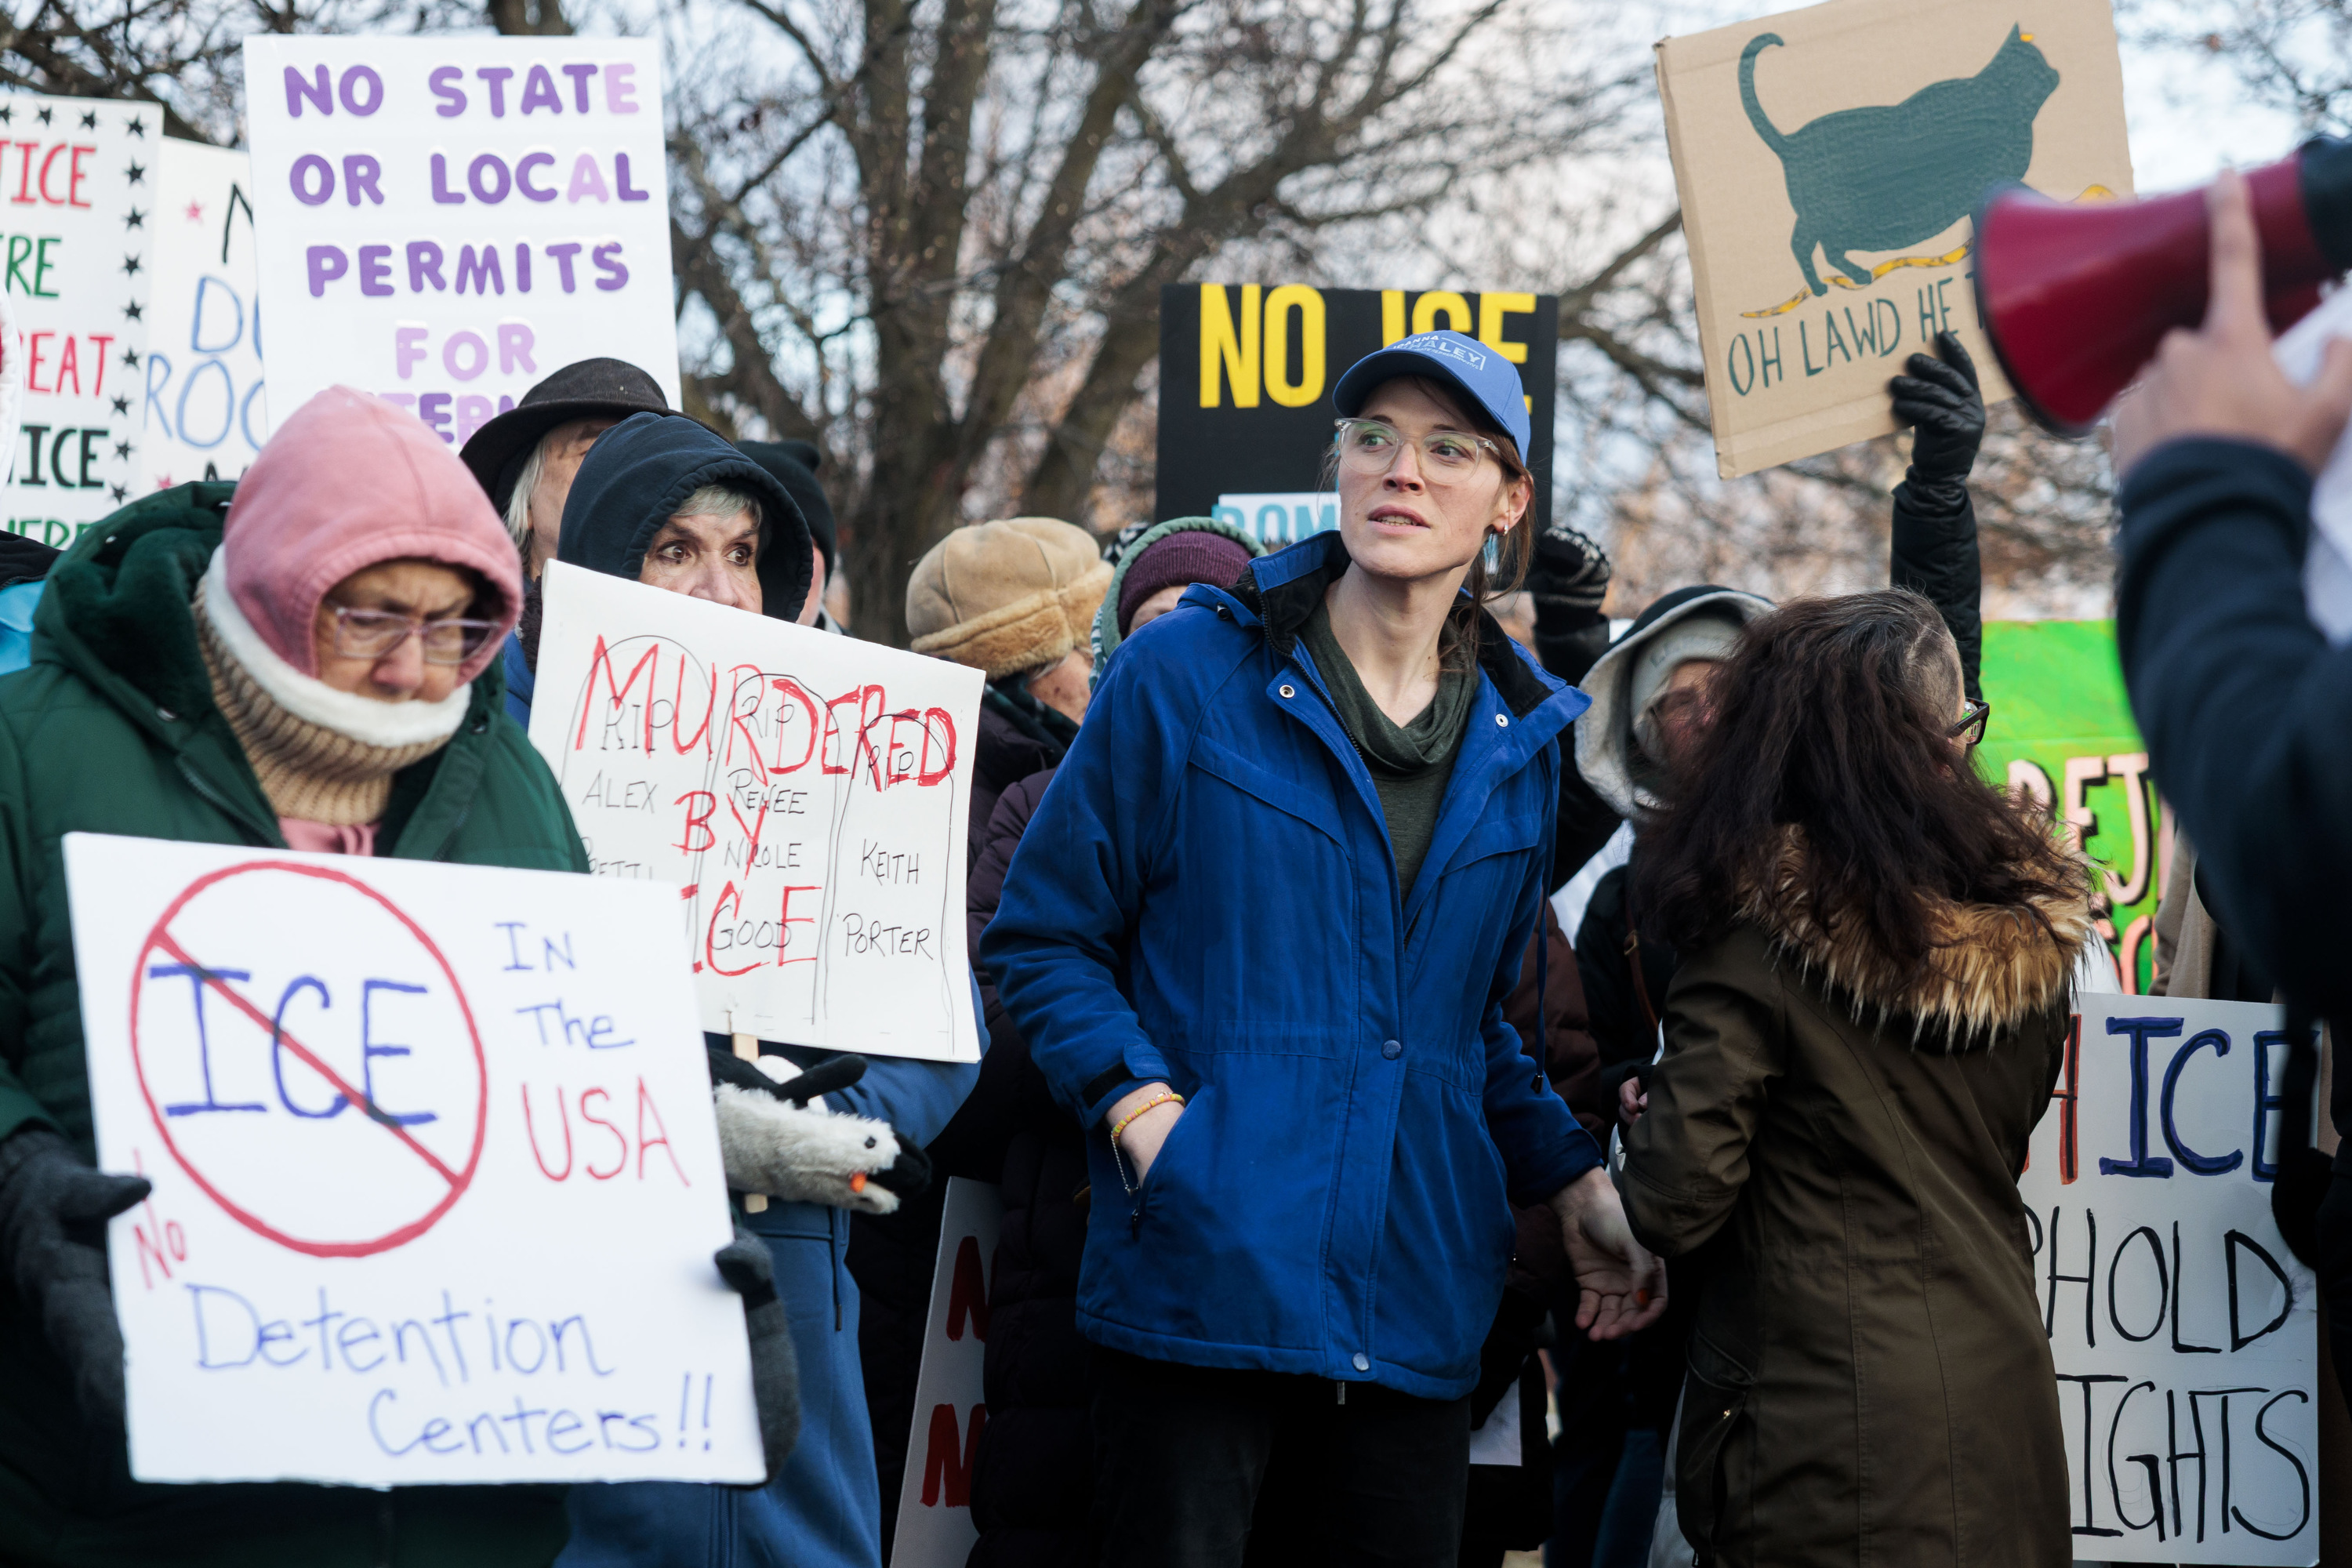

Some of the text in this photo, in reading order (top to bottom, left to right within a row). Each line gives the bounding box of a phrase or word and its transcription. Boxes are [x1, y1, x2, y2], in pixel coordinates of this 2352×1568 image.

[284, 64, 639, 118] NO STATE
[289, 152, 649, 206] OR LOCAL
[0, 234, 62, 298] RE
[307, 241, 629, 297] PERMITS
[19, 332, 115, 397] EAT
[395, 324, 537, 382] FOR
[1200, 282, 1327, 408] NO
[1403, 339, 1481, 363] HALEY
[1729, 326, 1782, 396] OH
[1800, 299, 1900, 377] LAWD
[1918, 277, 1958, 343] HE
[8, 424, 109, 489] ICE
[575, 633, 957, 793] MURDERED
[601, 695, 675, 751] RIP
[741, 695, 795, 739] RIP
[582, 769, 659, 814] ALEX
[728, 768, 808, 814] RENEE
[866, 745, 914, 791] RIP
[671, 790, 769, 880] BY
[724, 837, 802, 869] NICOLE
[861, 838, 919, 886] KEITH
[494, 921, 576, 971] IN
[710, 904, 792, 951] GOOD
[843, 913, 934, 960] PORTER
[148, 963, 439, 1126] ICE
[515, 996, 636, 1049] The
[521, 1074, 691, 1187] USA
[184, 1284, 616, 1387] Detention
[368, 1373, 713, 1455] Centers!!
[2056, 1374, 2310, 1543] IGHTS
